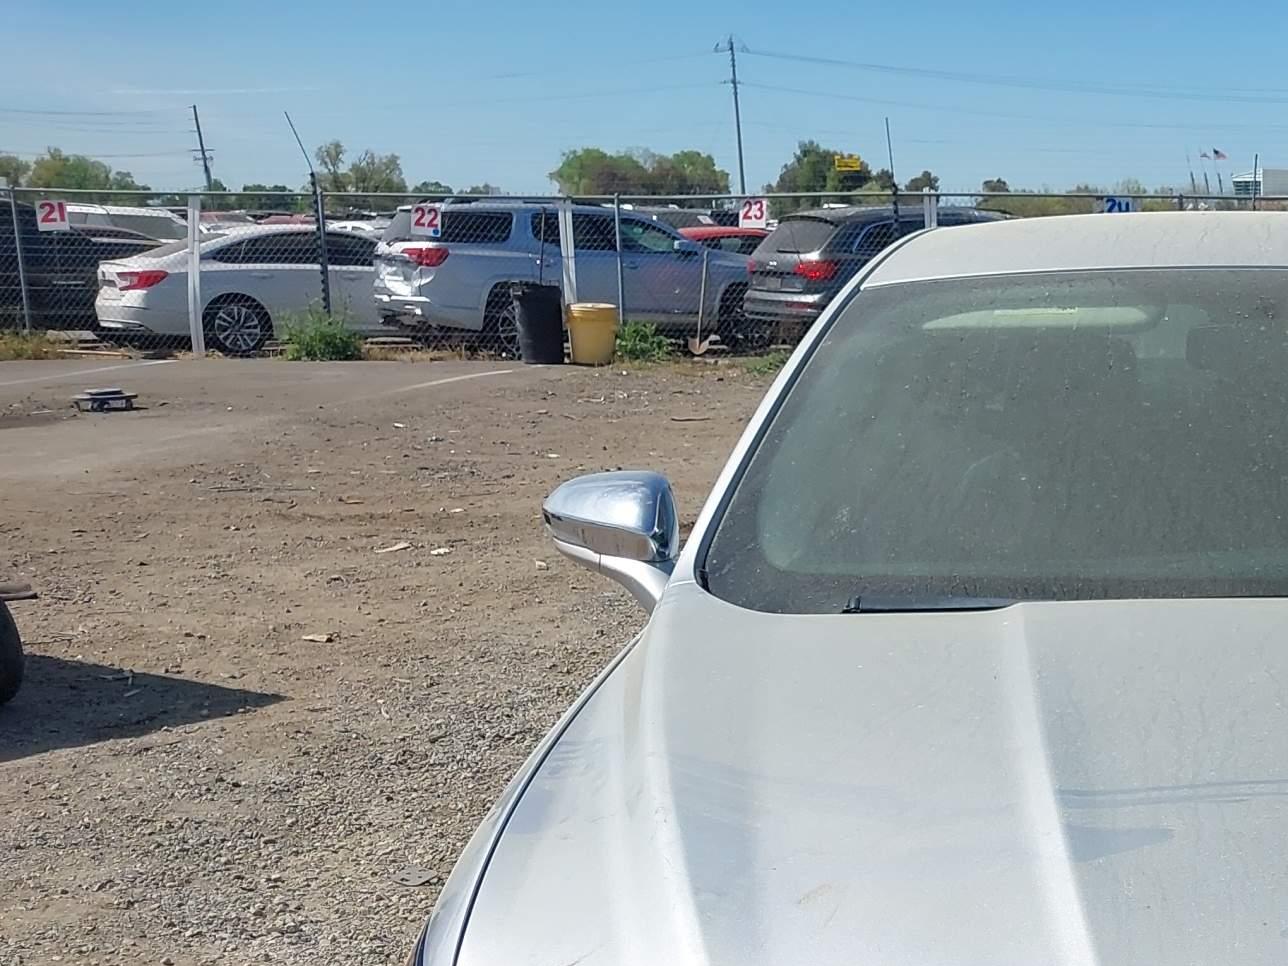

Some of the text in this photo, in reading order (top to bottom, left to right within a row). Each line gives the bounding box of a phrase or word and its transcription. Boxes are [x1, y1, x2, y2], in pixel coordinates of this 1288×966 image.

[39, 202, 66, 223] 21
[414, 207, 438, 228] 22
[742, 200, 764, 220] 23
